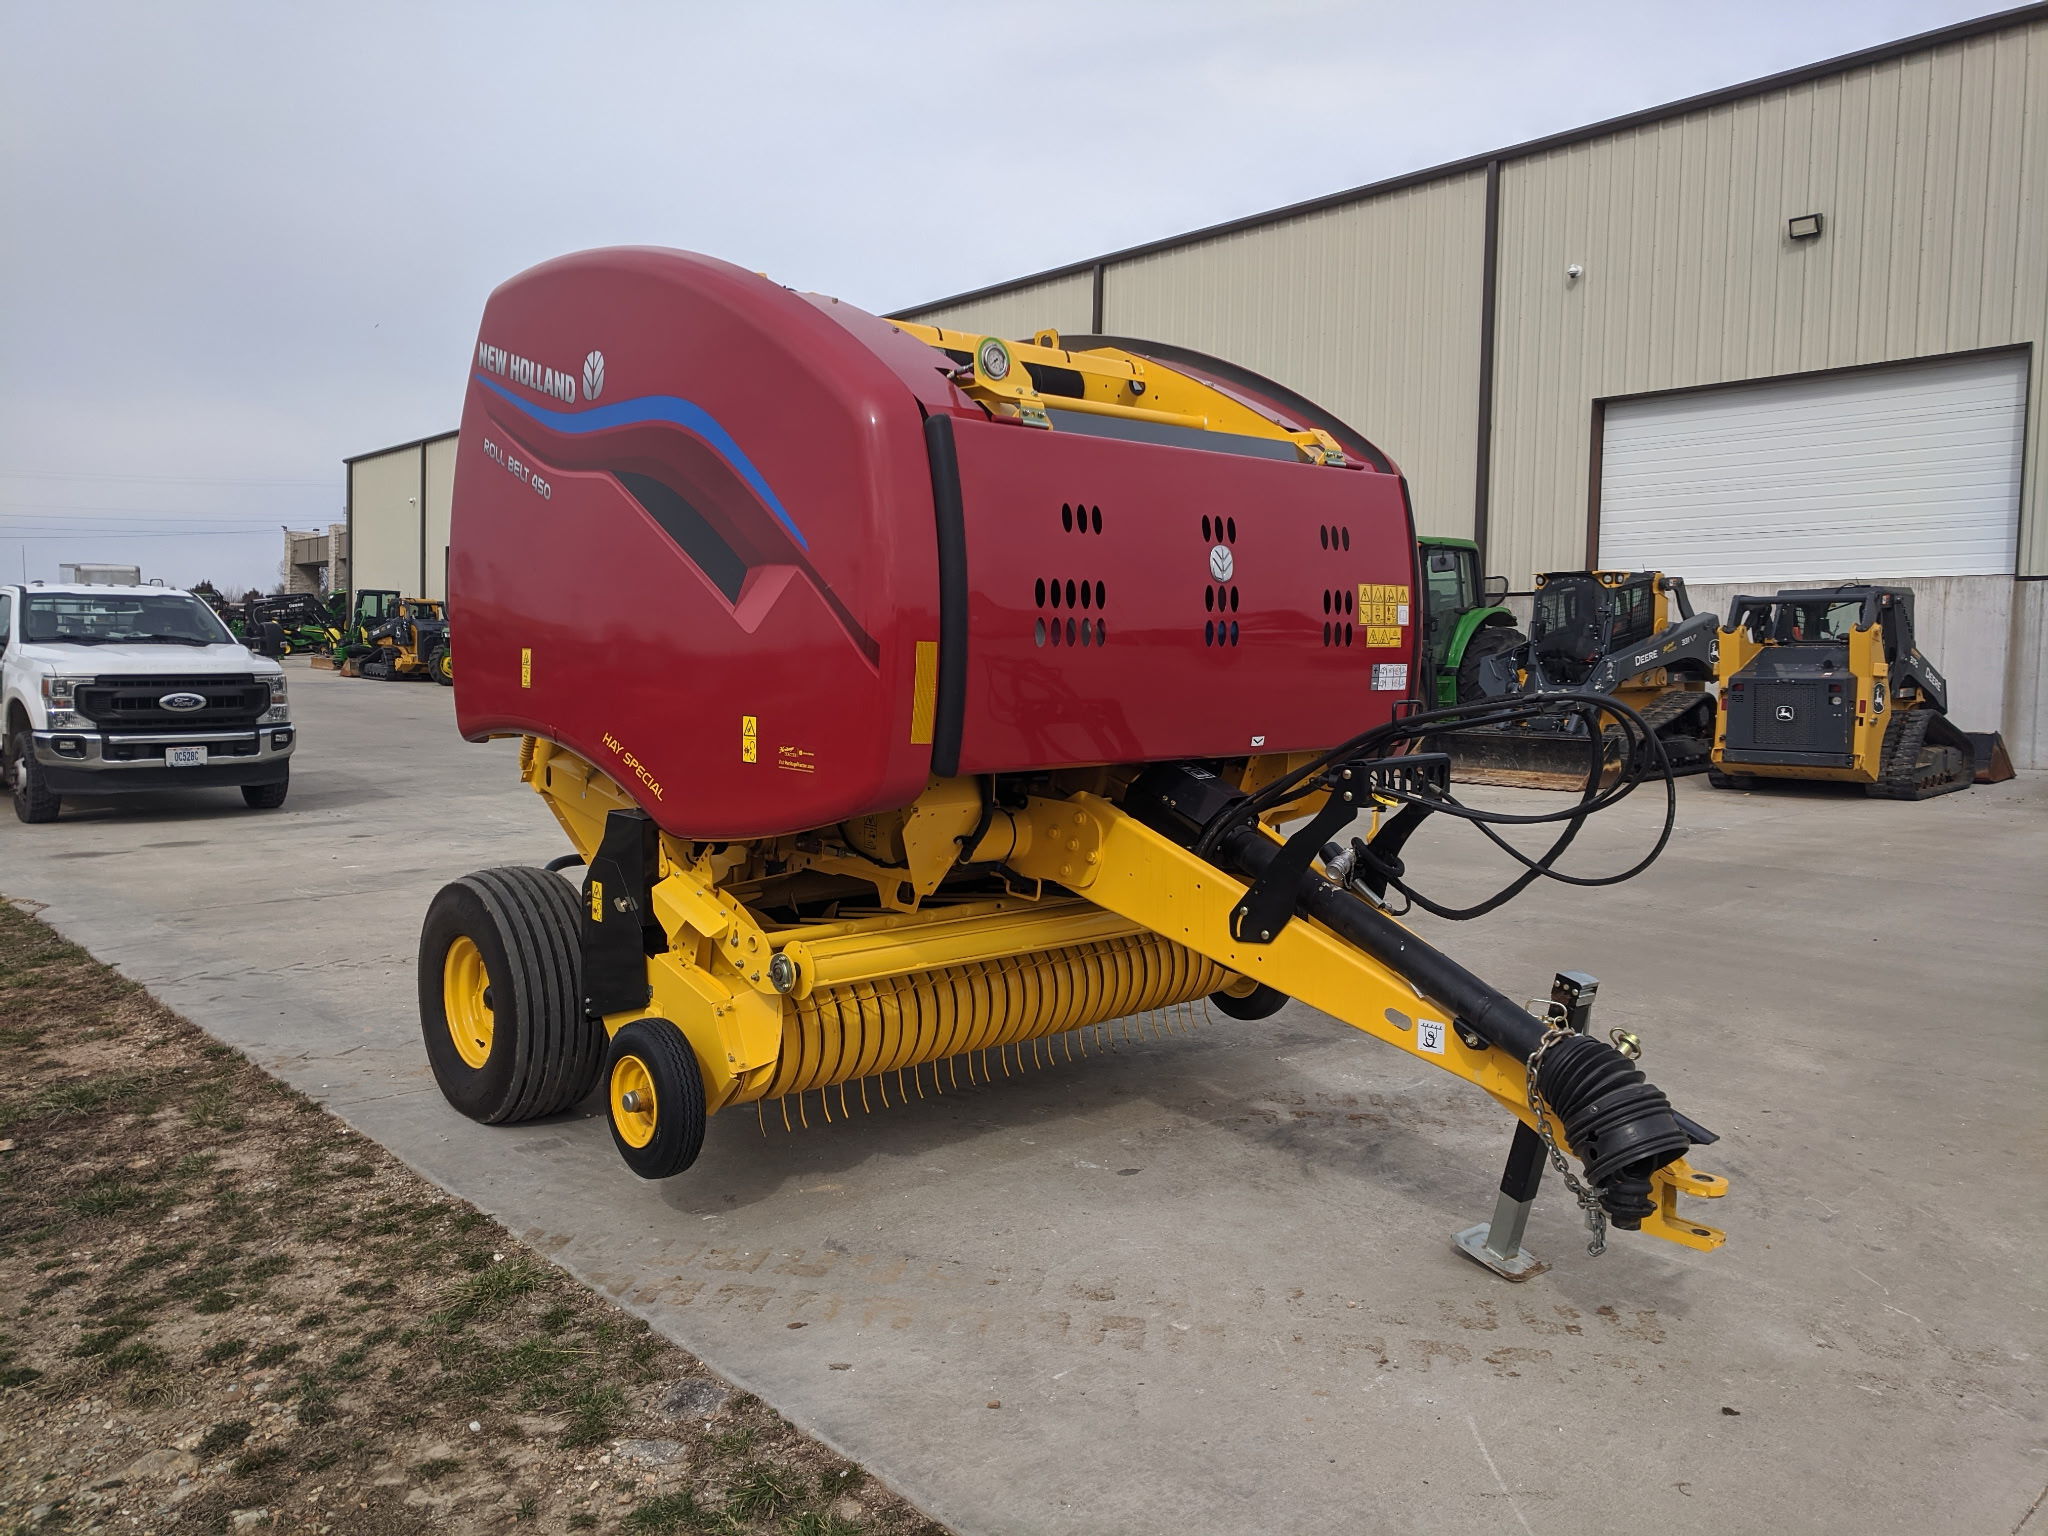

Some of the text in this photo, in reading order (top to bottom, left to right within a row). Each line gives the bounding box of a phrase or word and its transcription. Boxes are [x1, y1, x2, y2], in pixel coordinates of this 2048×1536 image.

[478, 340, 576, 404] NEW HOLLAND
[483, 437, 552, 501] ROLL BELT 450
[1634, 648, 1659, 667] DEERE
[1925, 666, 1942, 692] DEERE
[602, 732, 663, 802] HAY SPECIAL
